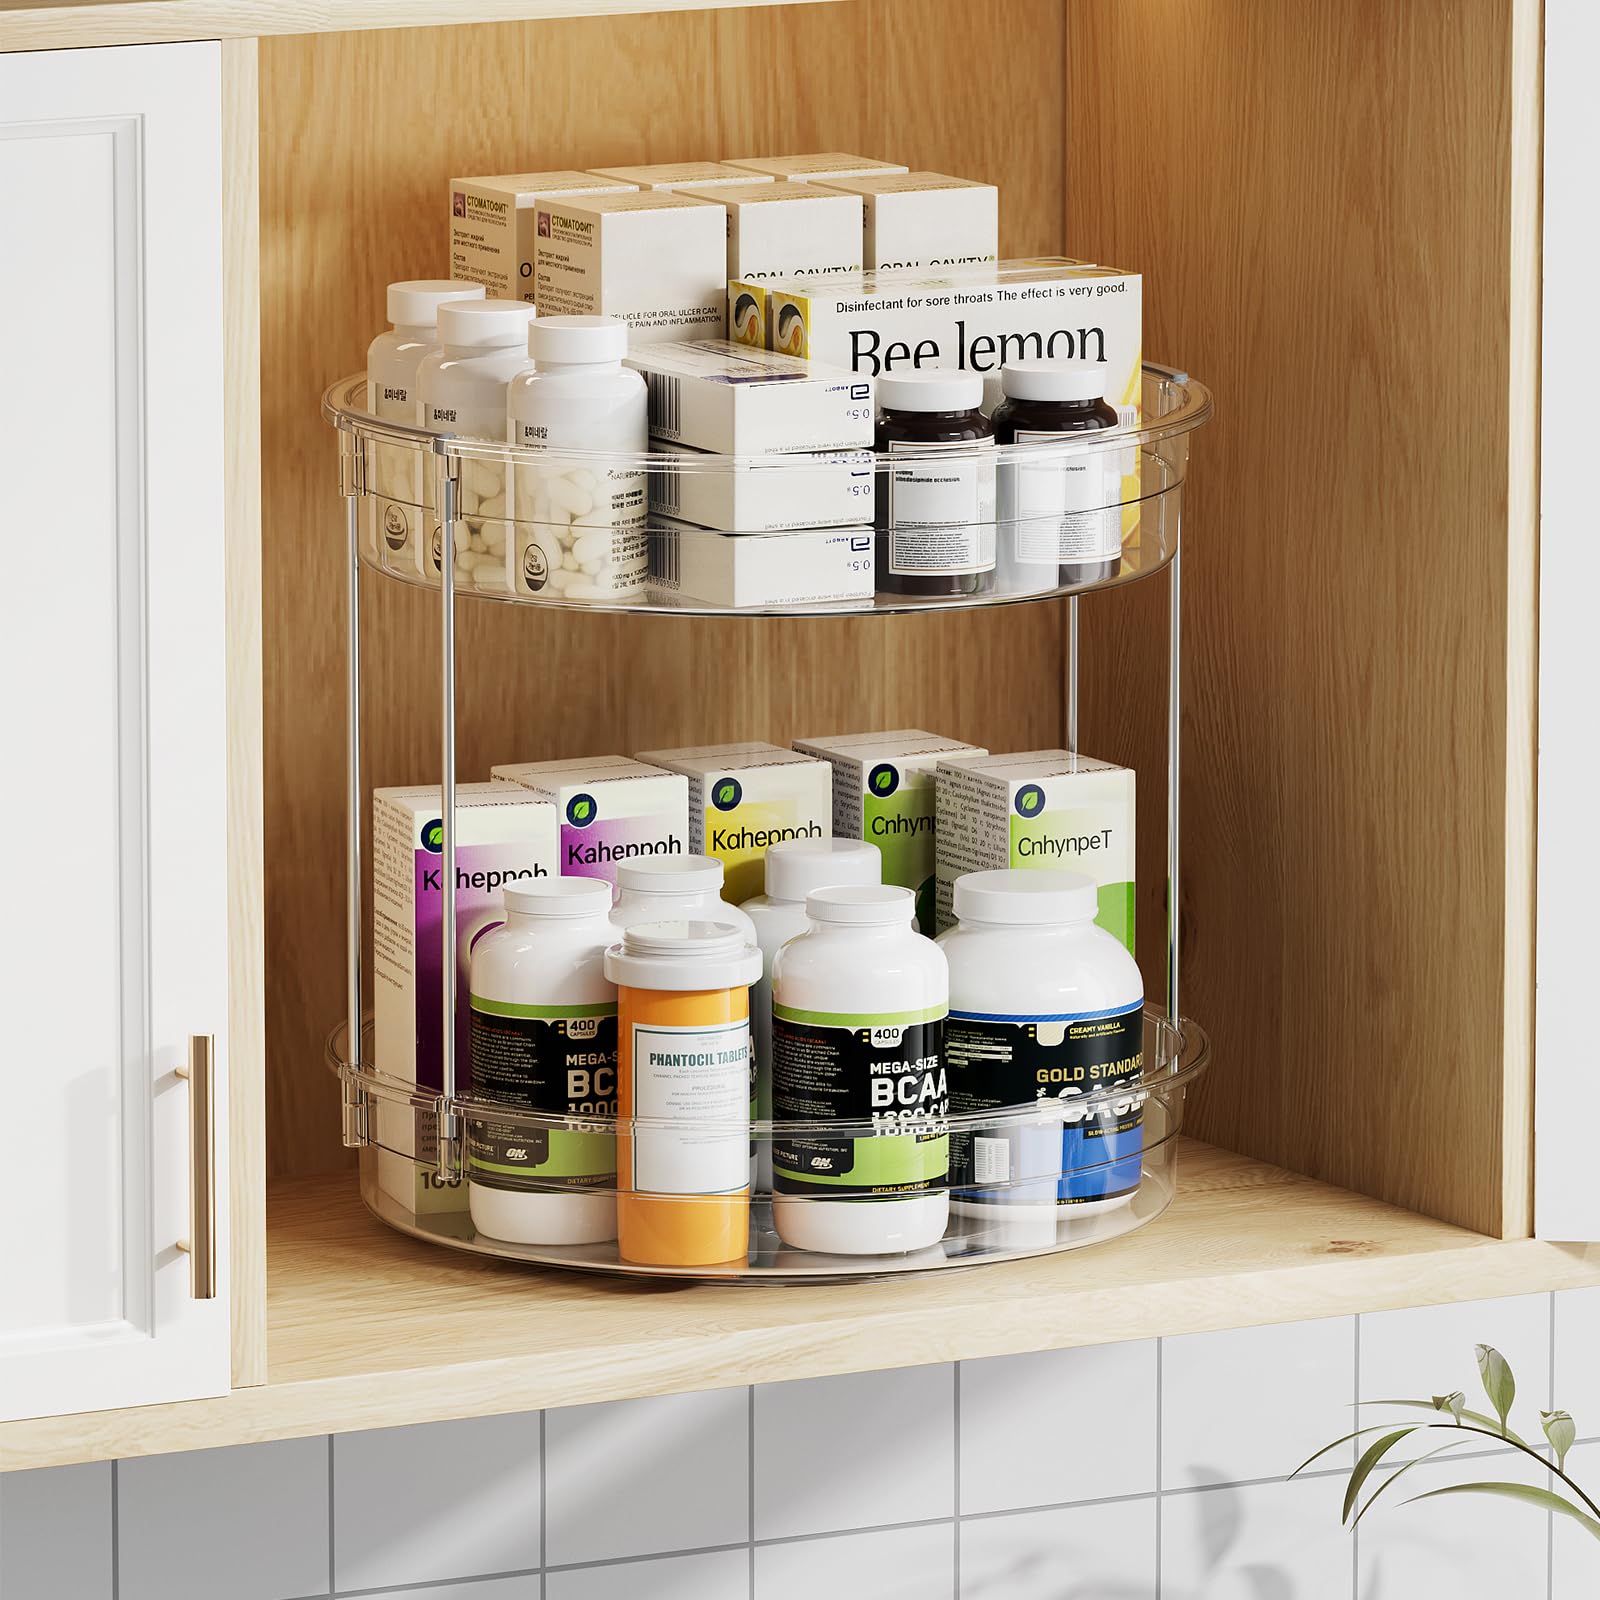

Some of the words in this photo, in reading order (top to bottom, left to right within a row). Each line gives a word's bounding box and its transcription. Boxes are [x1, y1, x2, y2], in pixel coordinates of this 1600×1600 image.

[836, 298, 904, 313] Disinfectant
[906, 296, 923, 308] for
[926, 296, 950, 306] sore
[954, 292, 993, 304] throats
[996, 290, 1018, 301] The
[1021, 288, 1052, 300] effect
[1056, 287, 1066, 298] is
[1069, 285, 1093, 298] very
[1096, 282, 1128, 296] good.
[643, 311, 657, 319] FOR
[658, 310, 676, 318] ORAL
[678, 308, 701, 316] ULCER
[702, 306, 718, 316] CAN
[652, 319, 668, 327] AND
[669, 316, 722, 326] INFLAMMATION
[848, 330, 940, 377] Bee
[954, 320, 1108, 372] lemon
[1018, 830, 1112, 857] CnhynpeT
[423, 863, 548, 893] Kheppoh
[570, 1020, 595, 1032] 400
[874, 1028, 899, 1039] 400
[1069, 1025, 1096, 1035] CREAMY
[1097, 1022, 1121, 1031] VANILLA
[566, 1052, 618, 1066] MEGA-S
[650, 1052, 714, 1067] PHANTOCIL
[717, 1046, 747, 1065] TABLETS
[870, 1055, 938, 1075] MEGA-SIZE
[567, 1068, 618, 1098] BC
[1036, 1066, 1085, 1083] GOLD
[871, 1068, 948, 1107] BCAA
[898, 1182, 930, 1192] SUPPLEMENT
